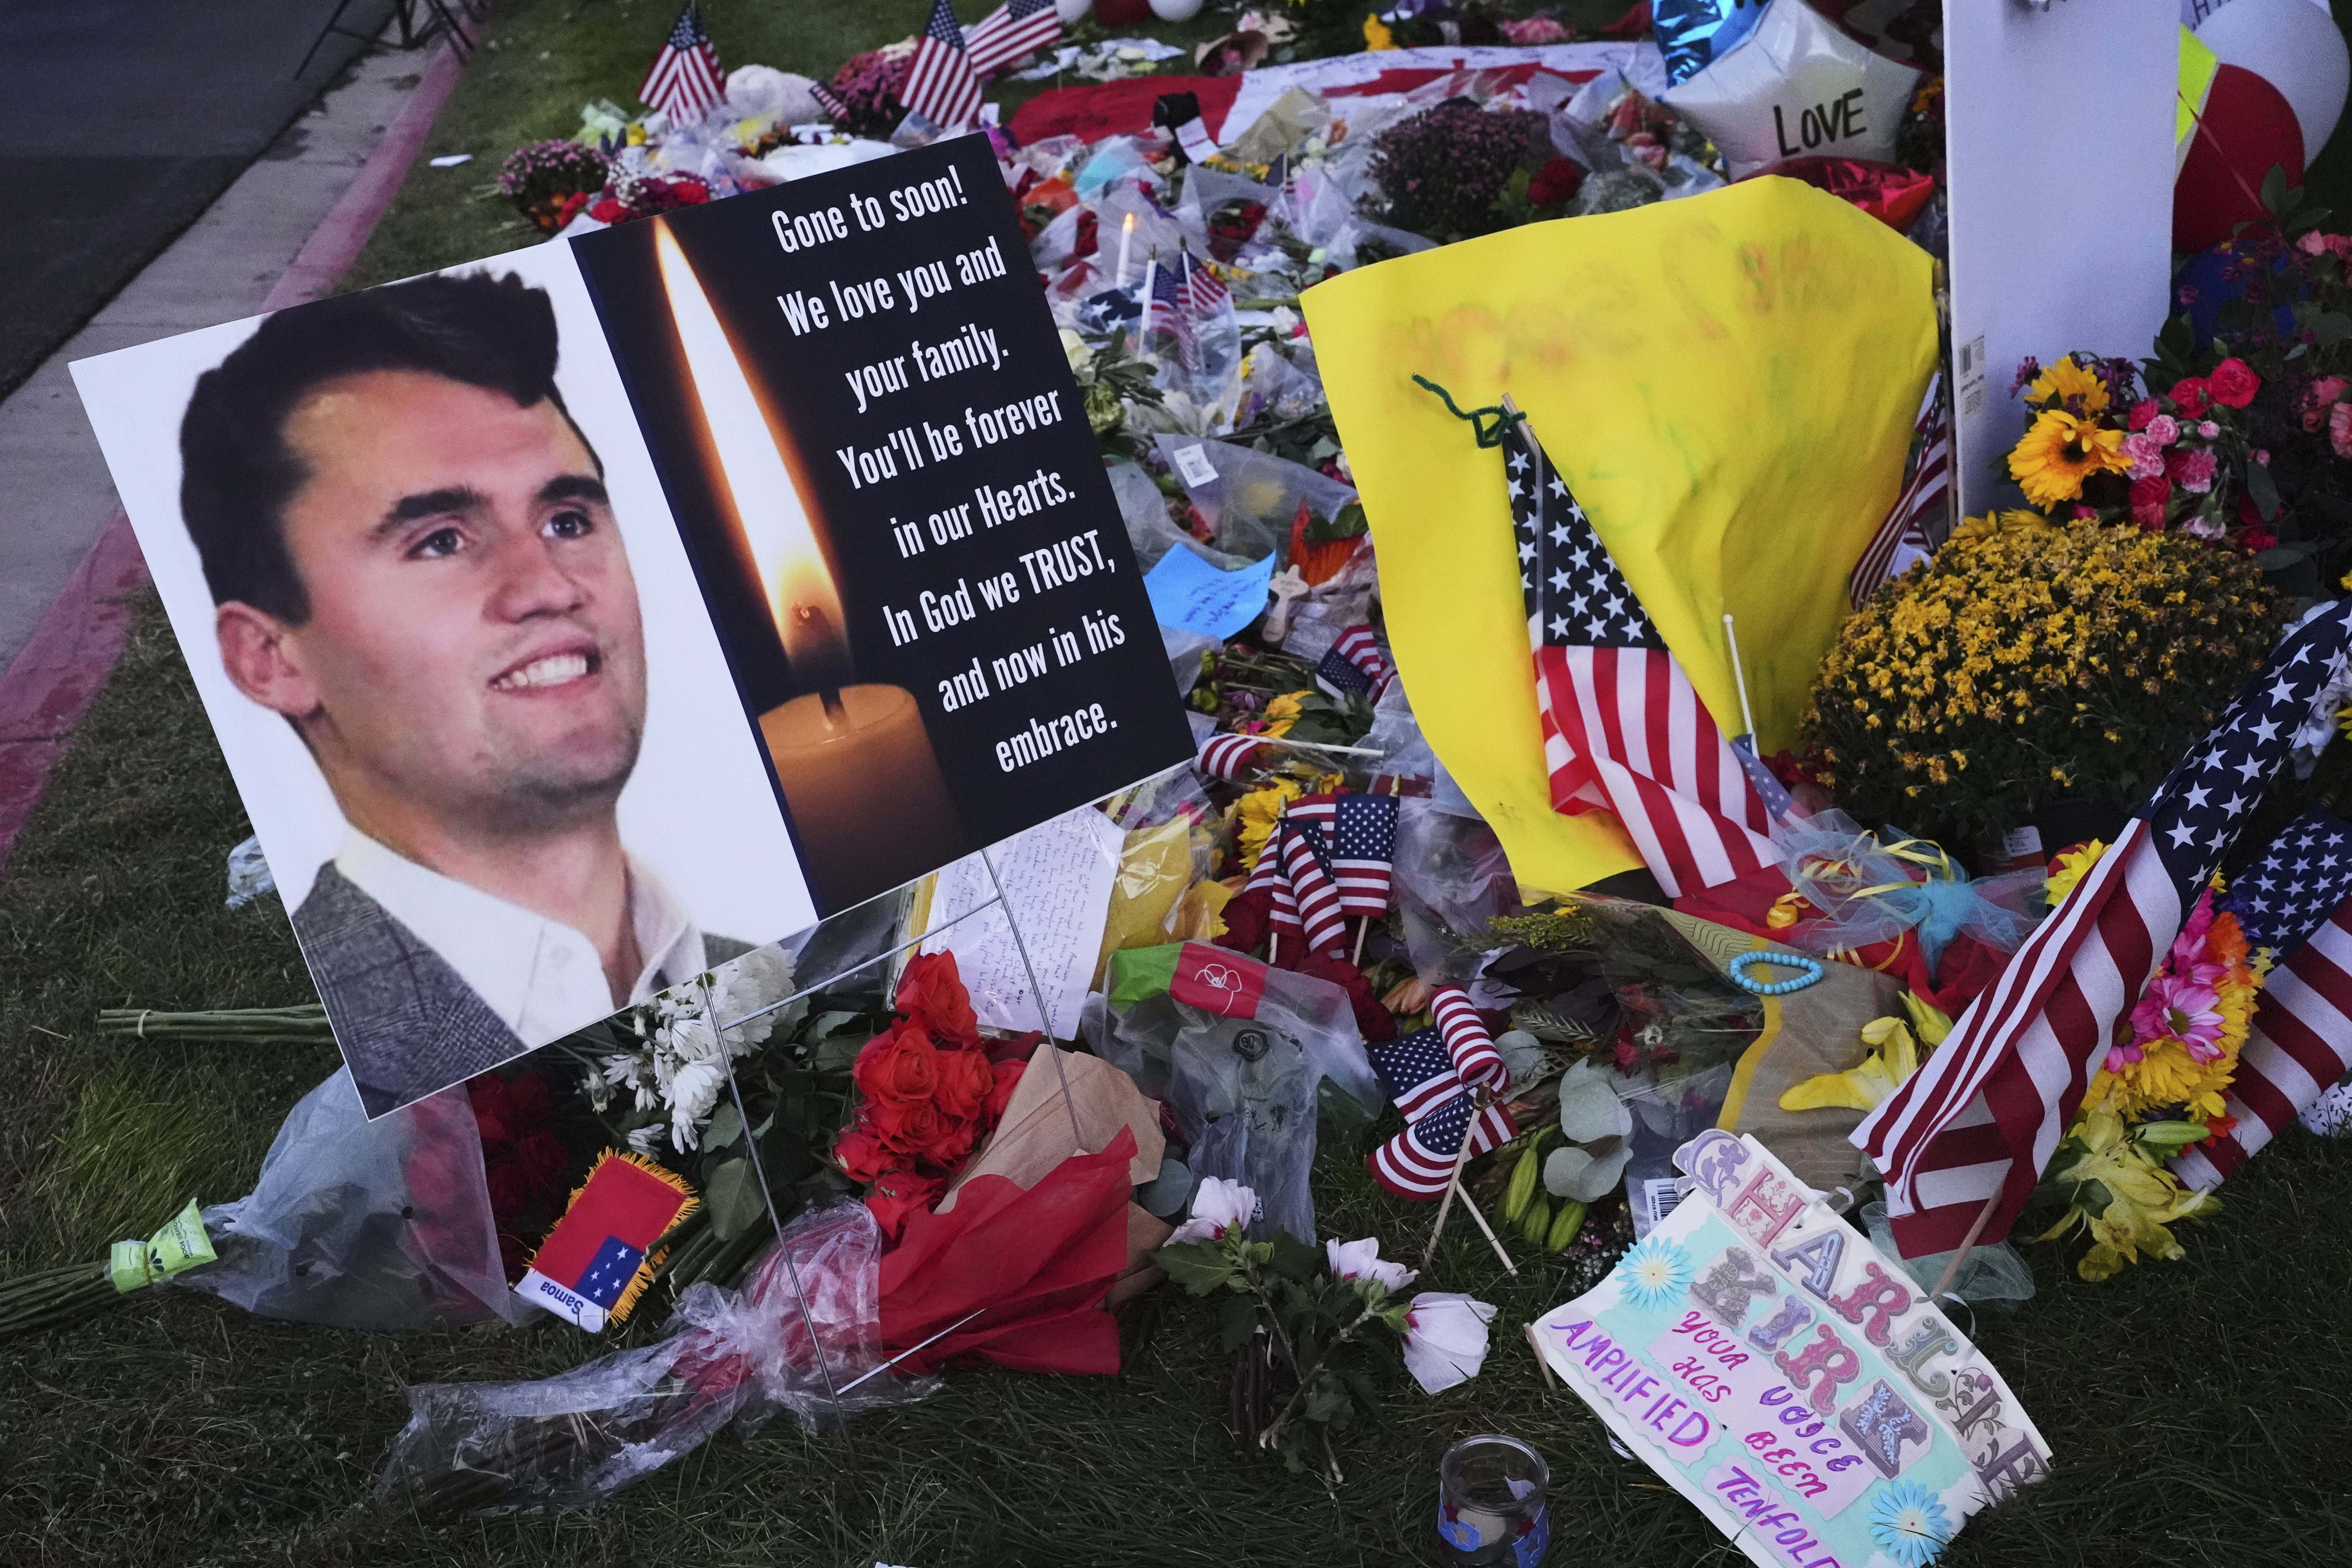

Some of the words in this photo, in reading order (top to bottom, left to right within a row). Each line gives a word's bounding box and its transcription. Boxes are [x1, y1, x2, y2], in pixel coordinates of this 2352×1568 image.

[1773, 87, 1867, 157] LOVE
[771, 207, 848, 253] Gone
[849, 193, 886, 232] to
[889, 164, 968, 222] soon!
[776, 290, 829, 336] We
[829, 277, 895, 322] love
[896, 260, 953, 314] you
[955, 235, 1007, 286] and
[844, 355, 909, 414] your
[911, 323, 1010, 382] family.
[836, 427, 925, 490] You'll
[922, 421, 963, 462] be
[964, 389, 1063, 449] forever
[890, 517, 925, 559] in
[928, 502, 974, 546] our
[974, 468, 1076, 529] Hearts.
[882, 605, 919, 647] In
[919, 577, 976, 633] God
[977, 572, 1020, 611] we
[1018, 529, 1115, 594] TRUST,
[938, 657, 990, 712] and
[992, 642, 1047, 691] now
[1048, 627, 1082, 667] in
[1081, 609, 1126, 655] his
[995, 703, 1118, 773] embrace.
[179, 1241, 190, 1259] FOOD
[540, 1281, 584, 1314] Samoa
[1675, 1131, 2049, 1500] CHARLIE
[1690, 1245, 1928, 1479] KIRK
[1549, 1320, 1710, 1447] AMPLIFIED
[1672, 1311, 1749, 1371] YOUR
[1760, 1385, 1863, 1472] VOICE
[1673, 1356, 1731, 1403] HAS
[1745, 1431, 1828, 1498] BEEN
